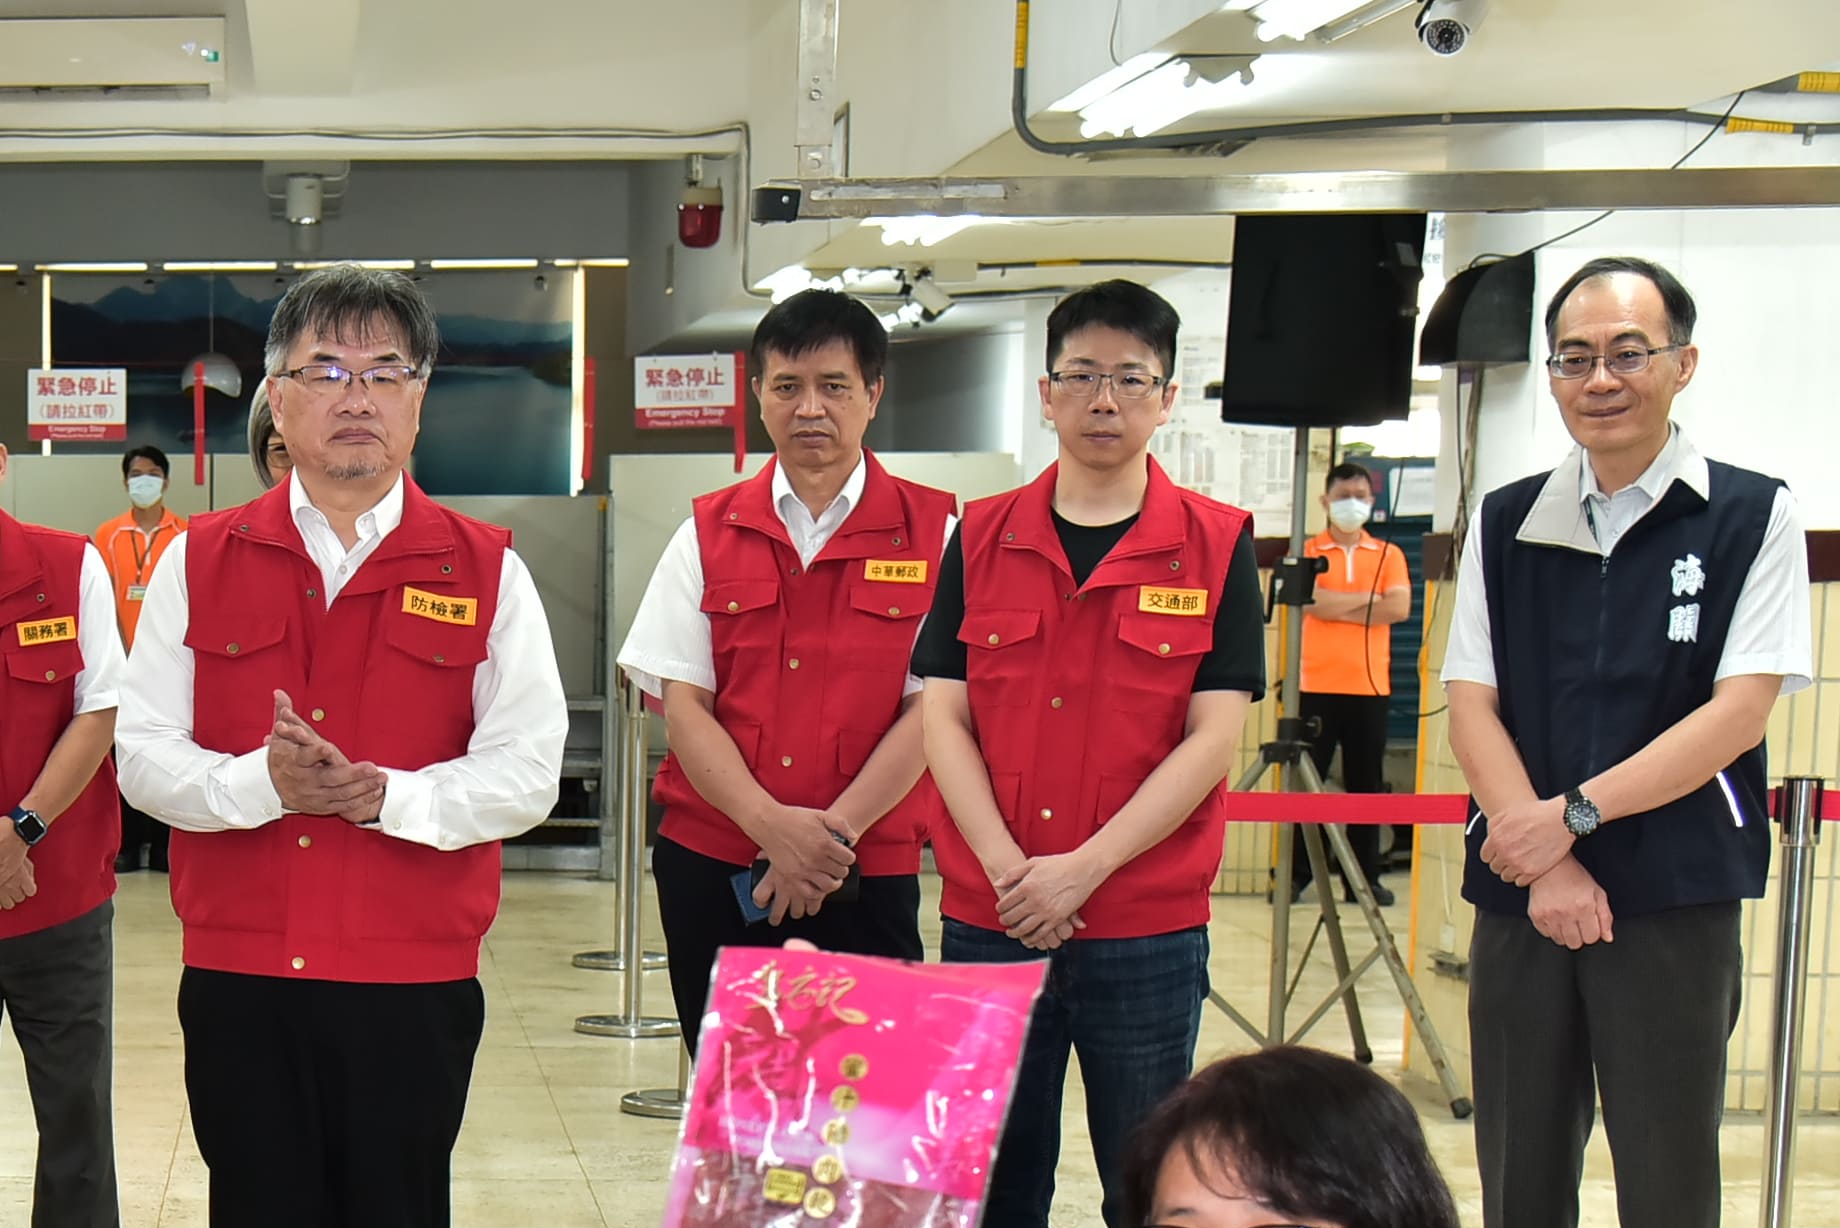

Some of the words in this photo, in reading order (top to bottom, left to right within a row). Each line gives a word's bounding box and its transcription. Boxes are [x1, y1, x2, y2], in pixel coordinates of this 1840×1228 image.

[37, 376, 117, 396] 緊急停止
[646, 367, 724, 387] 緊急停止
[872, 565, 919, 578] 中華郵政
[411, 595, 468, 620] 防檢署
[1147, 592, 1199, 611] 交通部
[1667, 553, 1706, 643] 海關
[24, 622, 68, 641] 關務署
